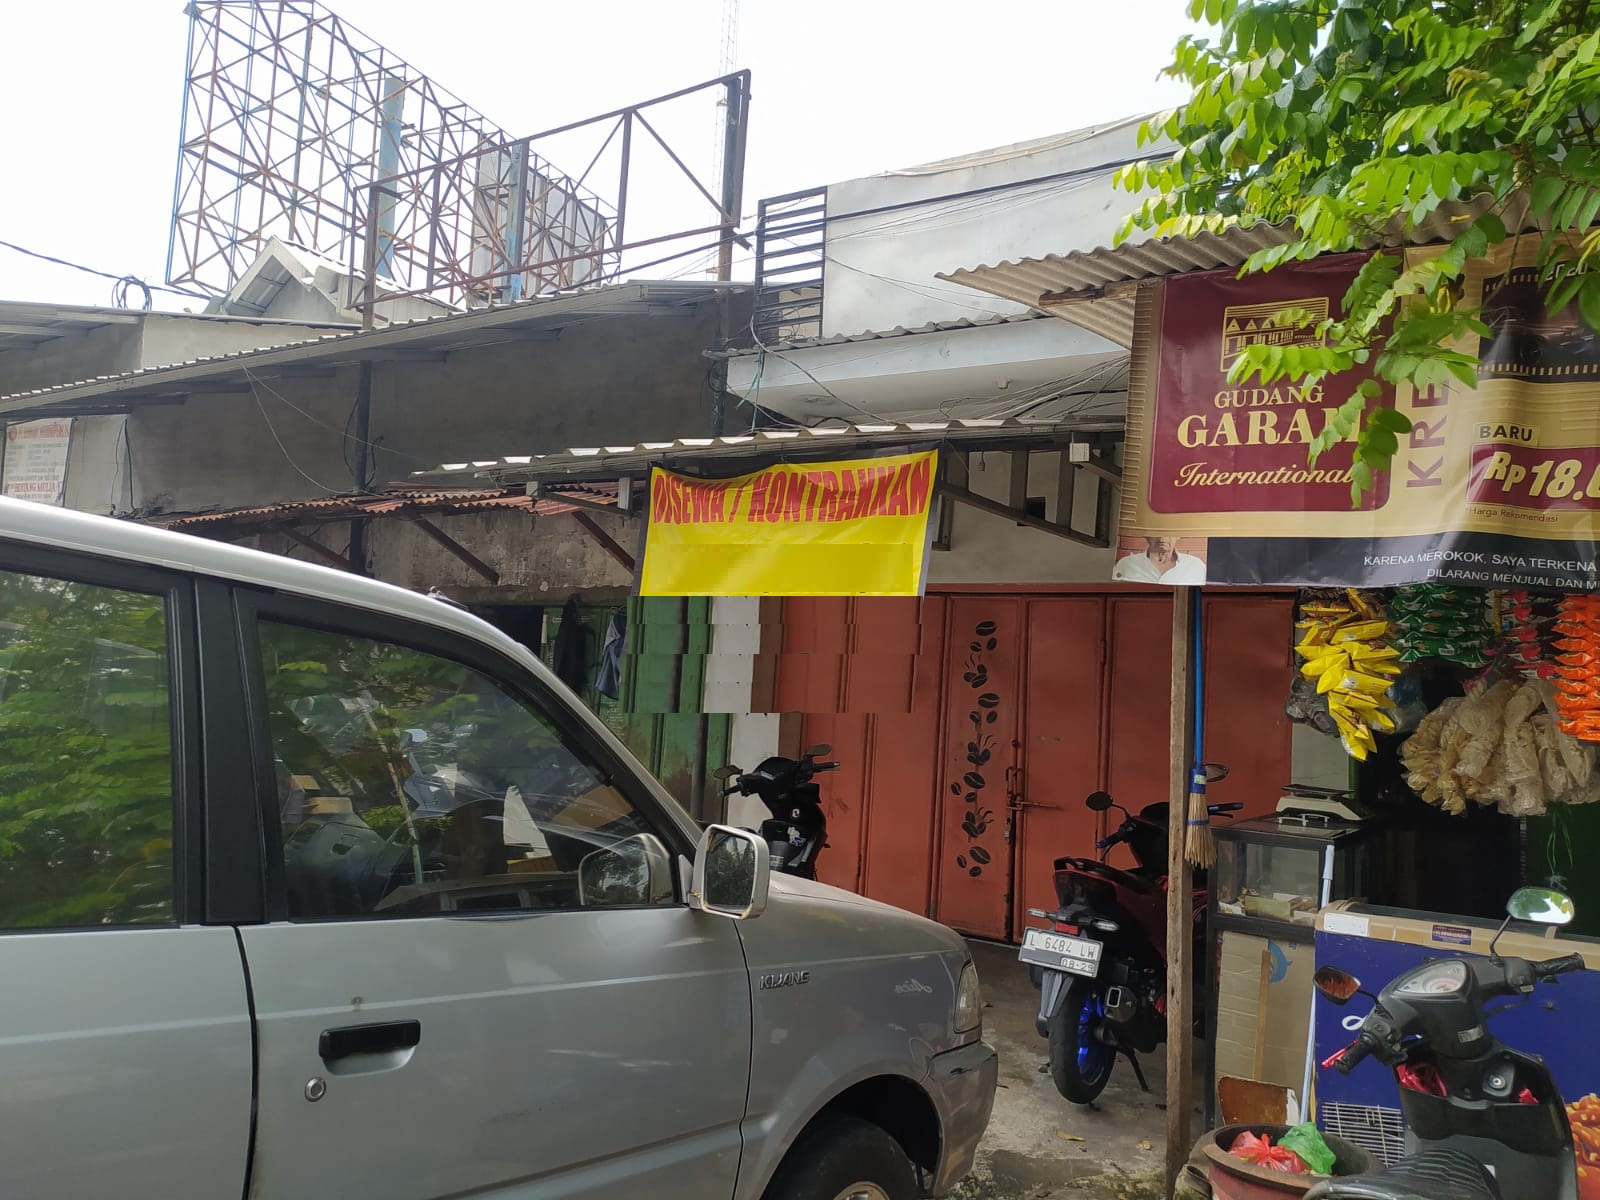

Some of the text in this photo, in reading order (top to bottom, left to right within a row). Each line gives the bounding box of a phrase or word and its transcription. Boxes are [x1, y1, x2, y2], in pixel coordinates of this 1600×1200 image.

[1214, 385, 1325, 408] GUDANG
[1406, 380, 1450, 488] KRE
[1479, 424, 1533, 442] BARU
[1174, 462, 1354, 487] International
[653, 472, 732, 525] DISEWA
[747, 457, 931, 524] KONTRAKKAN
[1500, 509, 1559, 523] Rekomendasi
[1363, 550, 1598, 572] KARENA MEROKOK, SAYA TERKENA
[1426, 568, 1490, 582] DILARANG
[1492, 572, 1553, 588] MENJUAL
[1555, 577, 1583, 589] DAN
[1030, 934, 1036, 947] L
[1044, 936, 1073, 953] 6484
[760, 970, 810, 990] KIJANG
